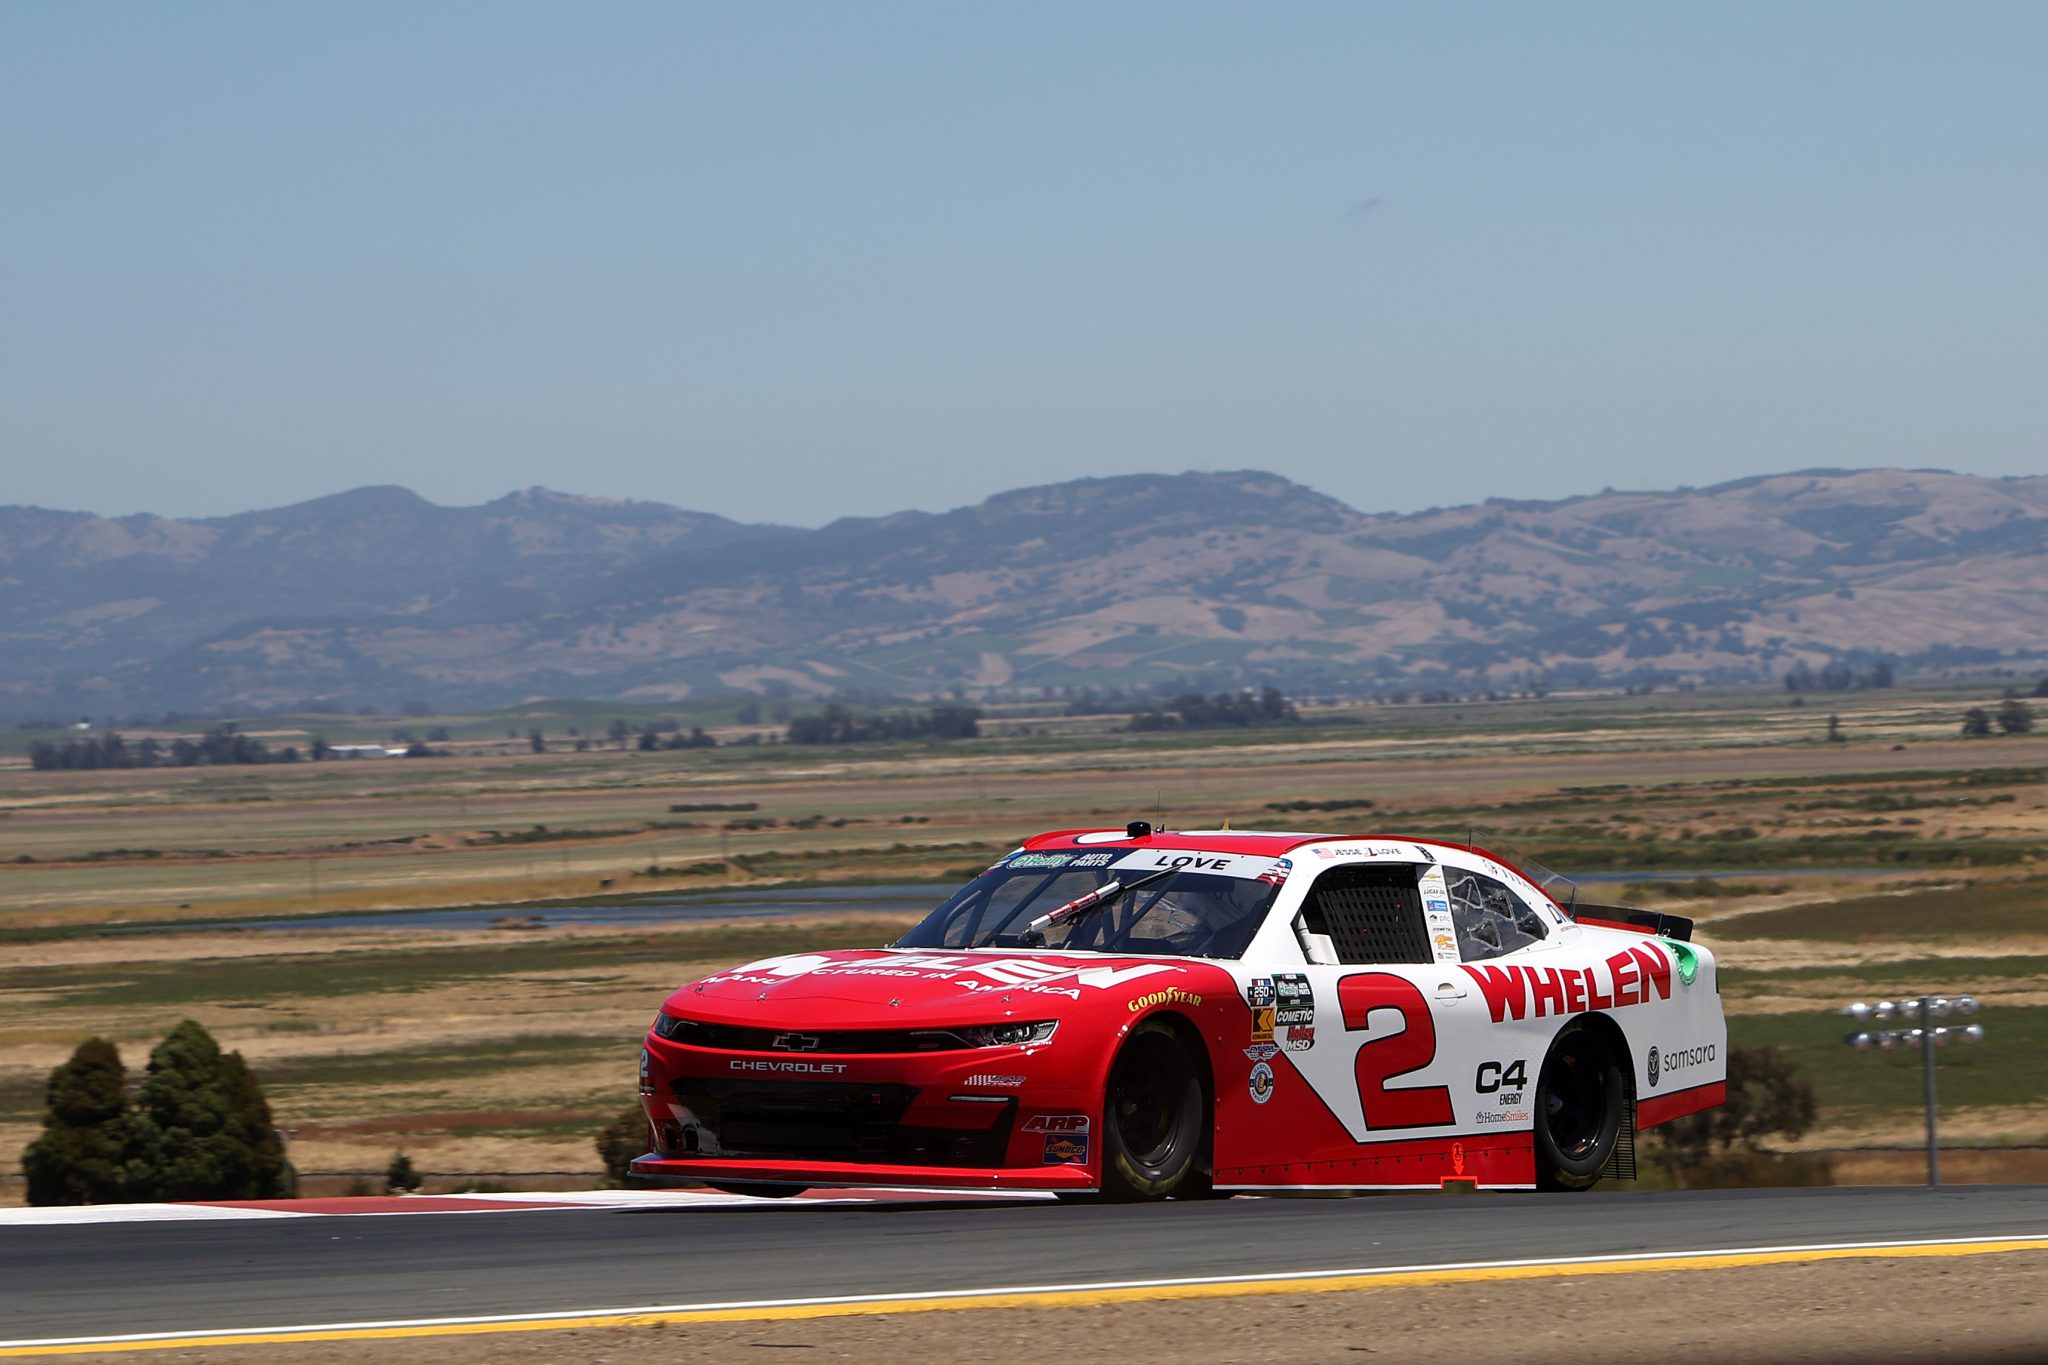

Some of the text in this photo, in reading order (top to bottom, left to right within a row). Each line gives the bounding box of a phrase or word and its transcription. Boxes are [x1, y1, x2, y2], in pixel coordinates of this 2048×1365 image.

[1079, 853, 1113, 861] AUTO
[1376, 847, 1402, 855] LOVE
[1068, 859, 1110, 867] PARTS
[1154, 854, 1231, 871] LOVE
[921, 971, 957, 980] IN
[1456, 940, 1672, 1024] WHELEN
[1253, 986, 1270, 998] 250
[1276, 1009, 1314, 1023] COMETIC
[1287, 1039, 1311, 1051] MSD
[1337, 971, 1457, 1132] 2
[1664, 1043, 1716, 1072] samsara
[729, 1060, 848, 1074] CHEVROLET
[1475, 1059, 1528, 1094] C4
[1499, 1092, 1523, 1106] ENERGY
[1484, 1110, 1529, 1123] HomeSmiles
[1026, 1115, 1089, 1133] ARP
[1046, 1144, 1086, 1155] SUNOCO
